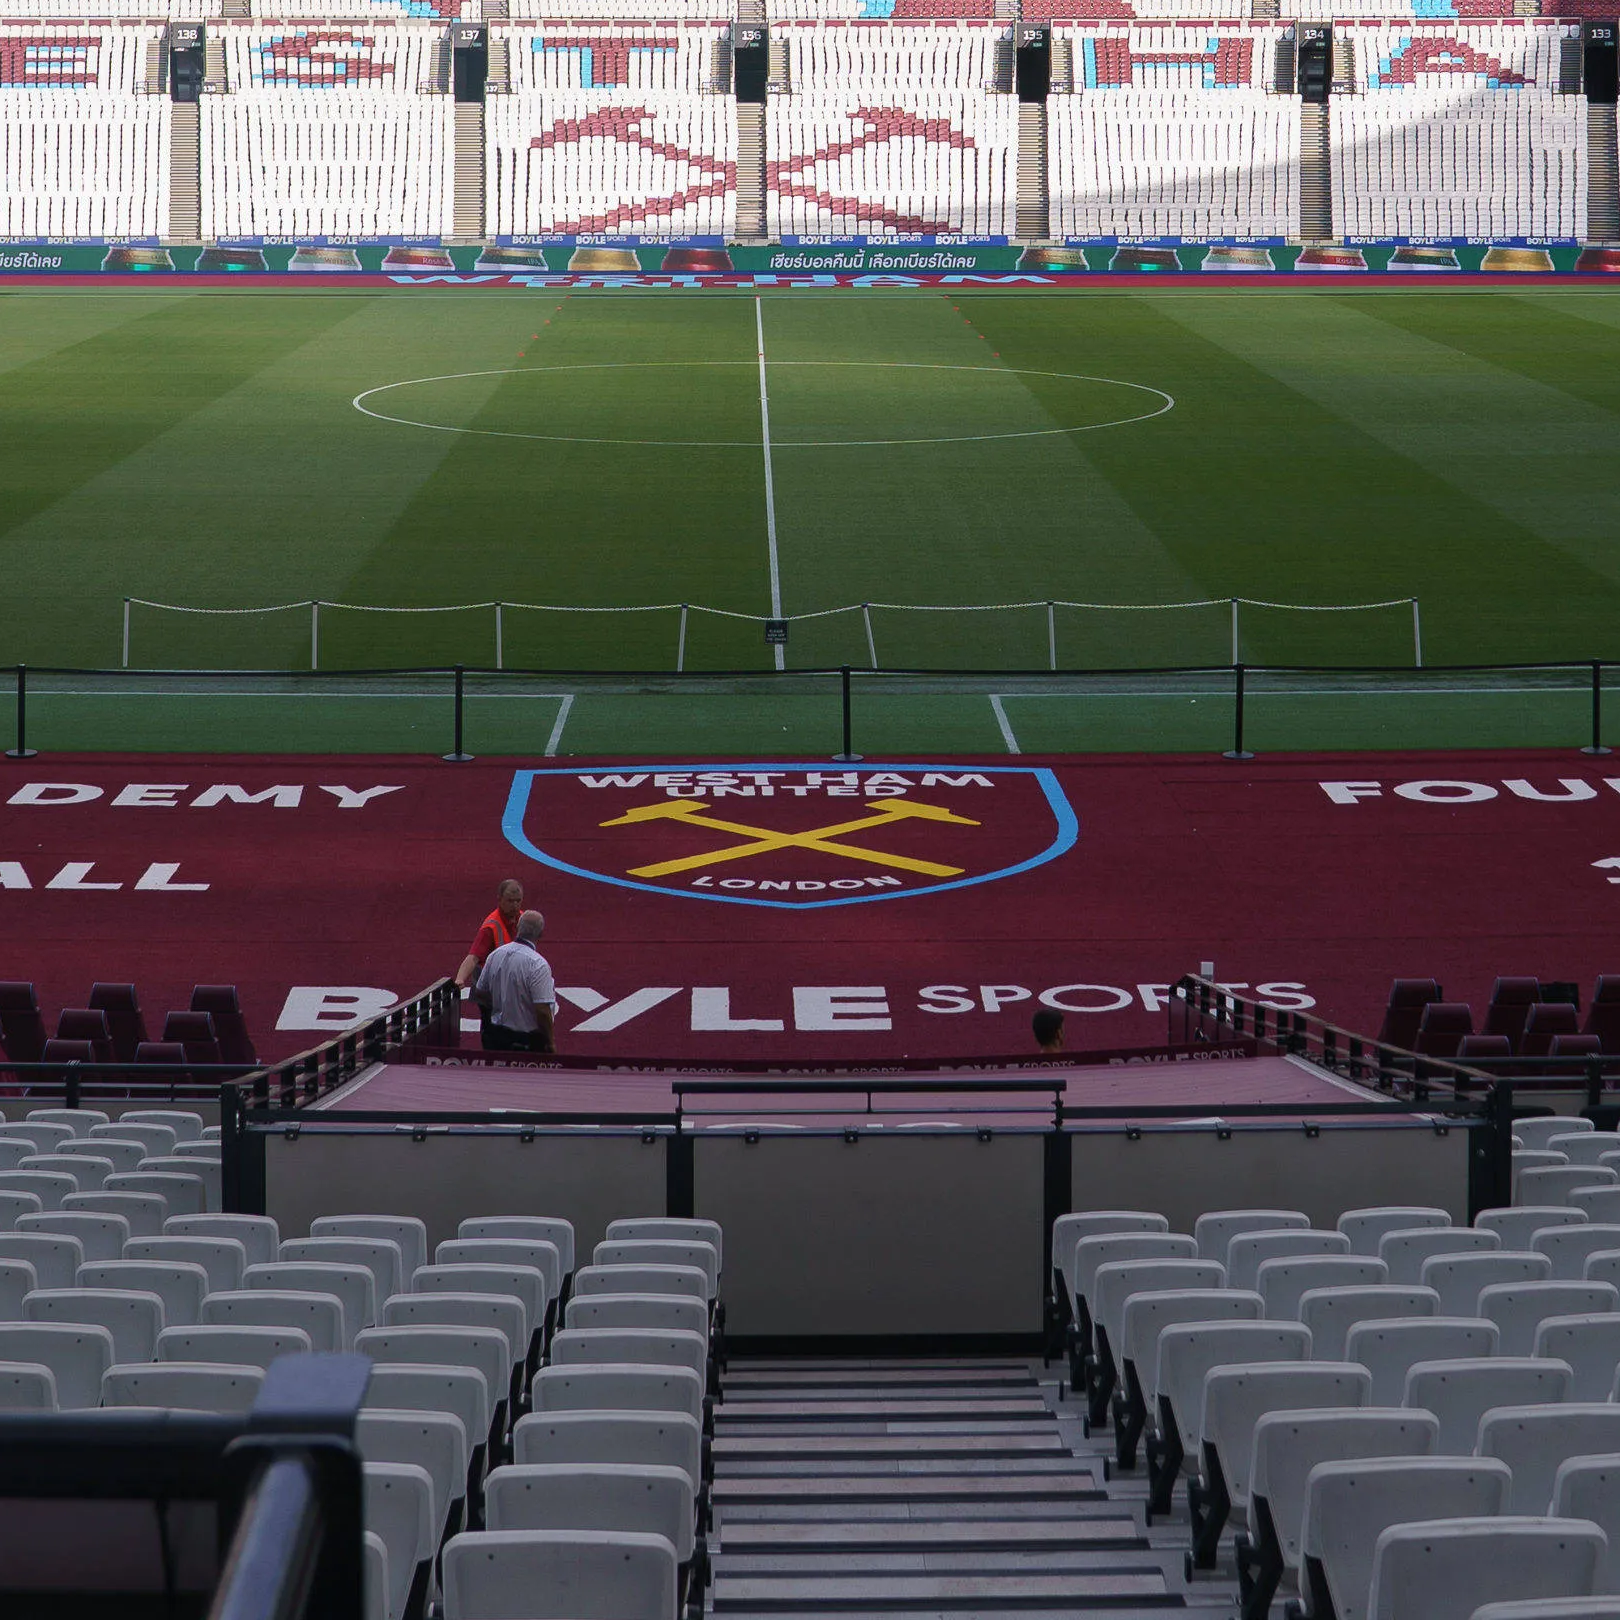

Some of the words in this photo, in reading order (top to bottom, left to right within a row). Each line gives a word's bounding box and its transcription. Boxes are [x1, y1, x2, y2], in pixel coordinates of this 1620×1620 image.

[178, 29, 197, 39] 138
[461, 30, 479, 40] 137
[742, 30, 761, 40] 136
[1024, 30, 1043, 40] 135
[1305, 30, 1324, 39] 134
[1591, 29, 1611, 39] 133
[263, 236, 293, 244] BOYLE
[327, 236, 358, 244] BOYLE
[512, 236, 542, 244] BOYLE
[576, 236, 606, 244] BOYLE
[640, 236, 669, 244] BOYLE
[799, 236, 831, 244] BOYLE
[867, 236, 900, 244] BOYLE
[936, 236, 968, 244] BOYLE
[770, 248, 865, 268] เชียร์บอลคืนนี้
[868, 252, 976, 268] เลือกเบียร์ได้เลย
[579, 772, 786, 789] WEST
[806, 771, 995, 788] HAM
[666, 785, 907, 797] UNITED
[691, 875, 903, 891] LONDON
[275, 986, 893, 1032] BYLE
